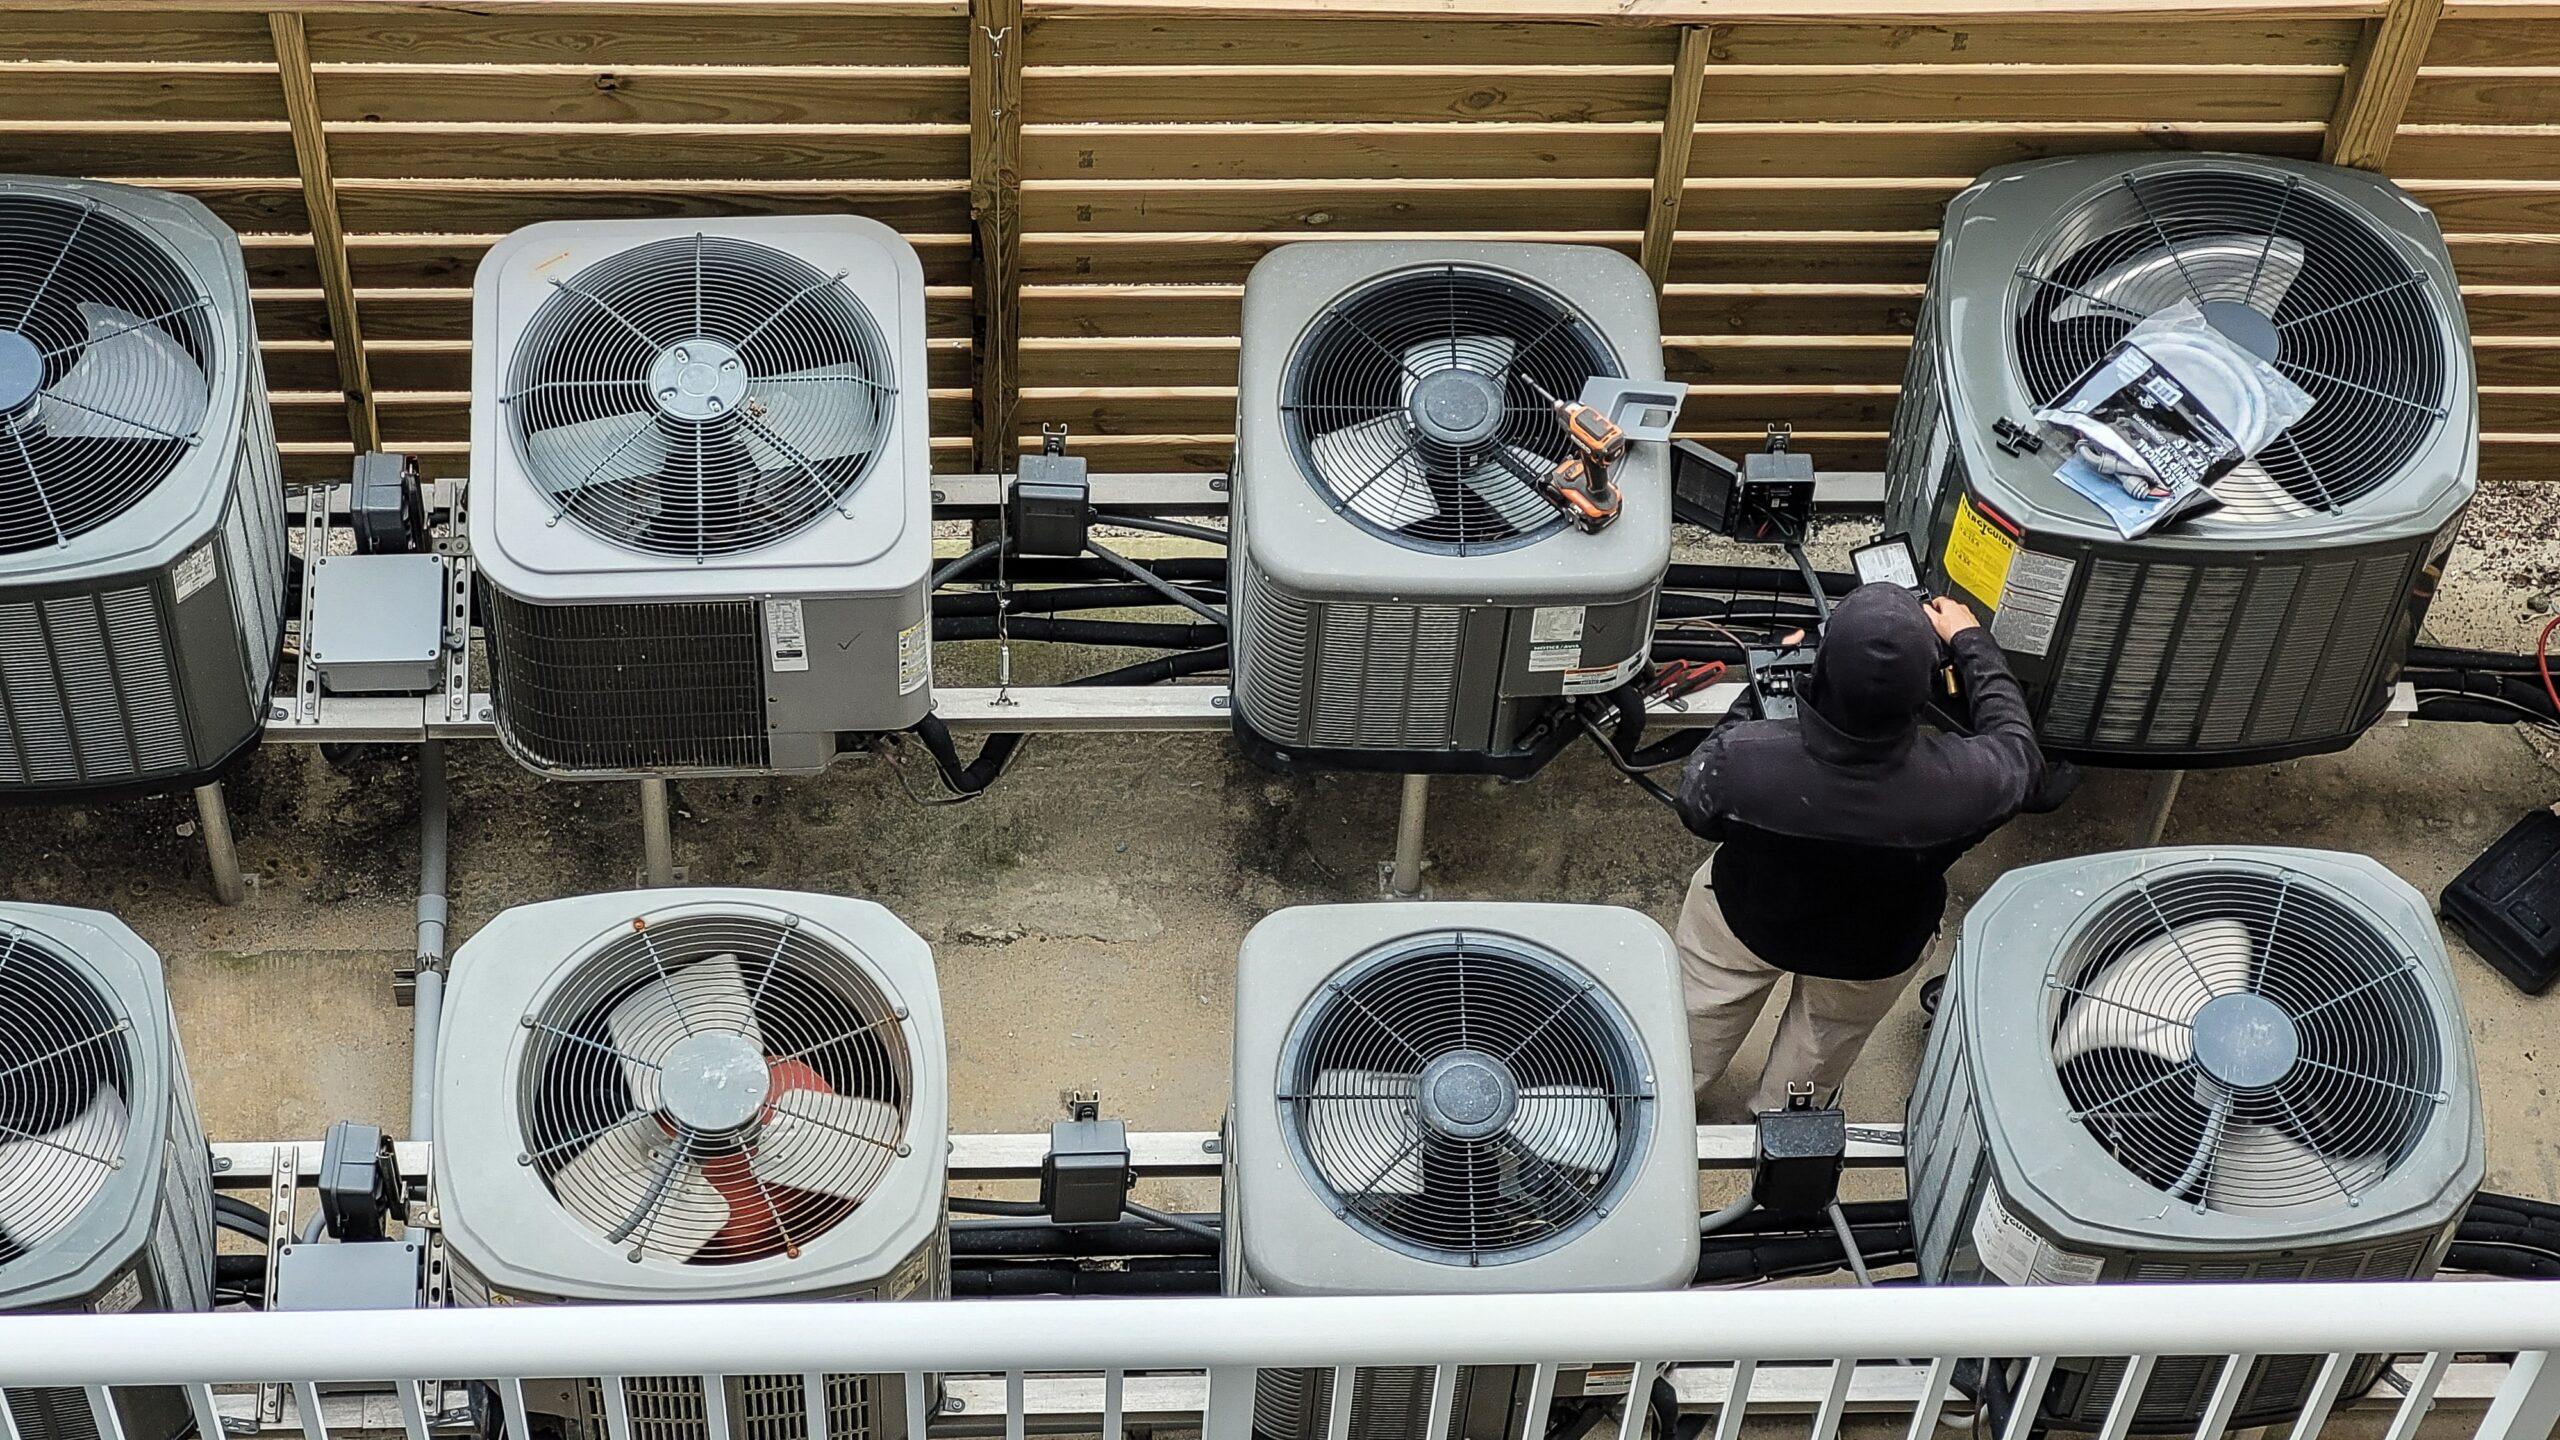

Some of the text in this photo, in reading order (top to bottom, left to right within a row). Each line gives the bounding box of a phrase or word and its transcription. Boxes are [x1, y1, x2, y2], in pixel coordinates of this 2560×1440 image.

[2132, 412, 2166, 443] CONNECTORS
[2134, 437, 2183, 492] ELECTRICAL
[2154, 445, 2173, 463] KIT
